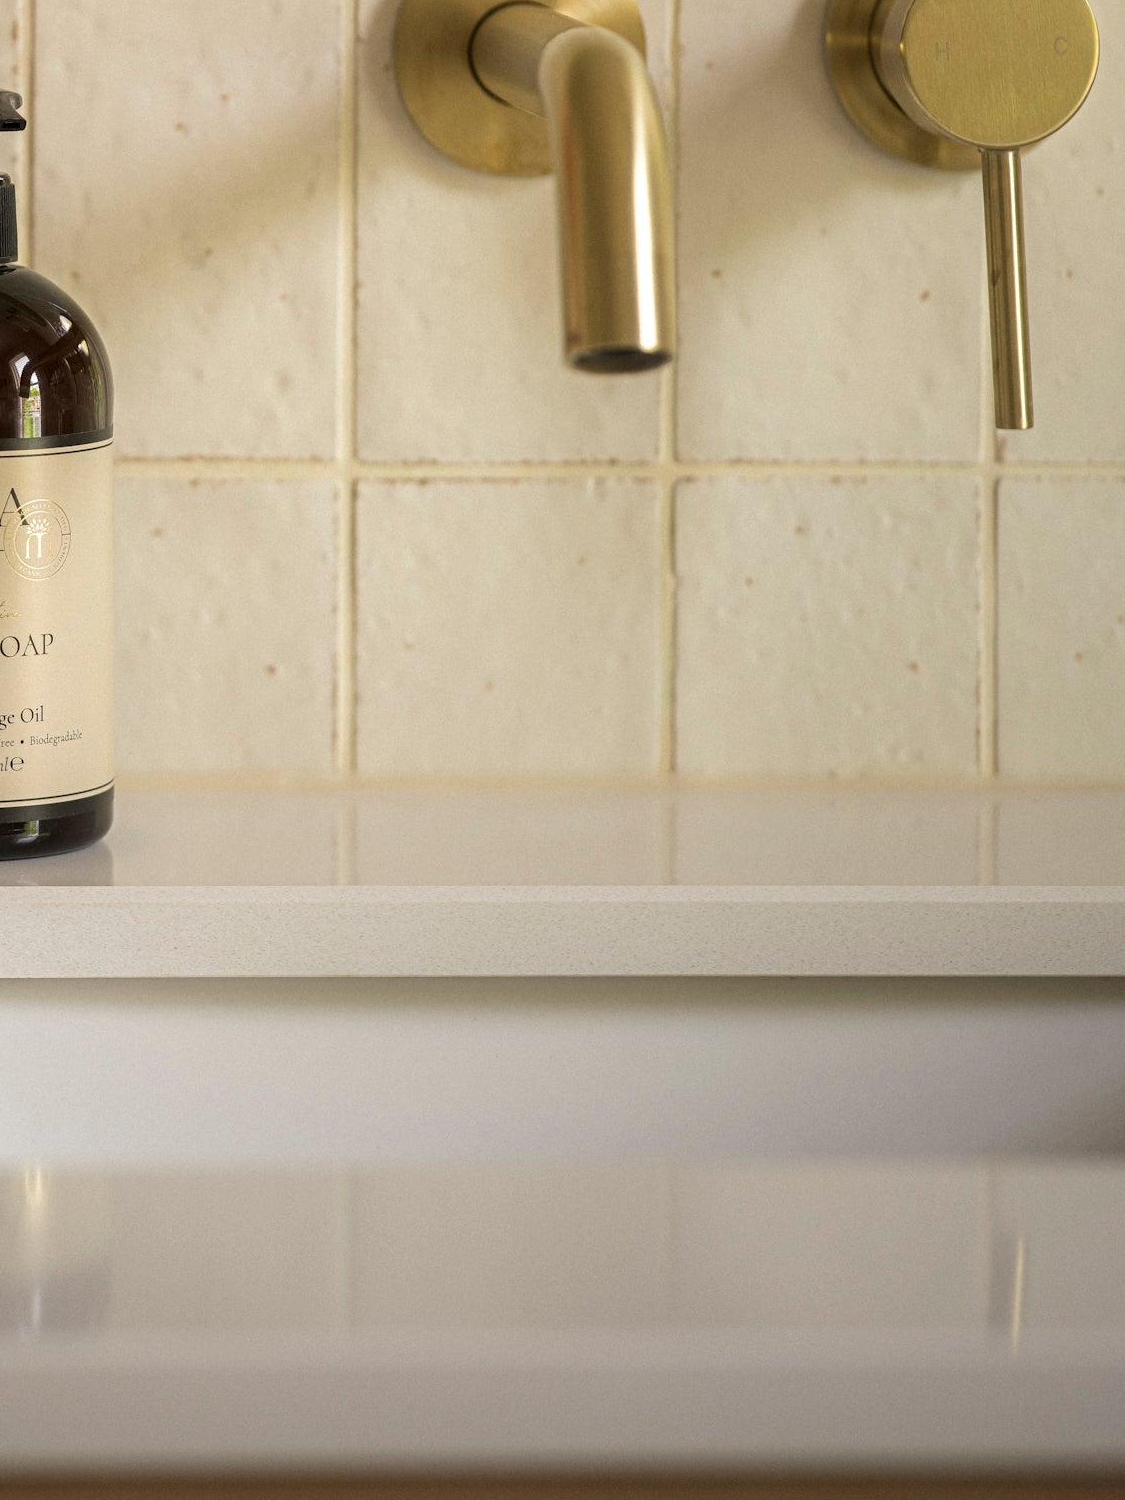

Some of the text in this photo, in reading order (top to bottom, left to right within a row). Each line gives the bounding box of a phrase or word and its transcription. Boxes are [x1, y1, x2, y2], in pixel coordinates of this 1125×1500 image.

[934, 41, 949, 61] H
[1052, 35, 1068, 55] C
[20, 705, 45, 723] Oil
[29, 729, 83, 747] Biodegradable
